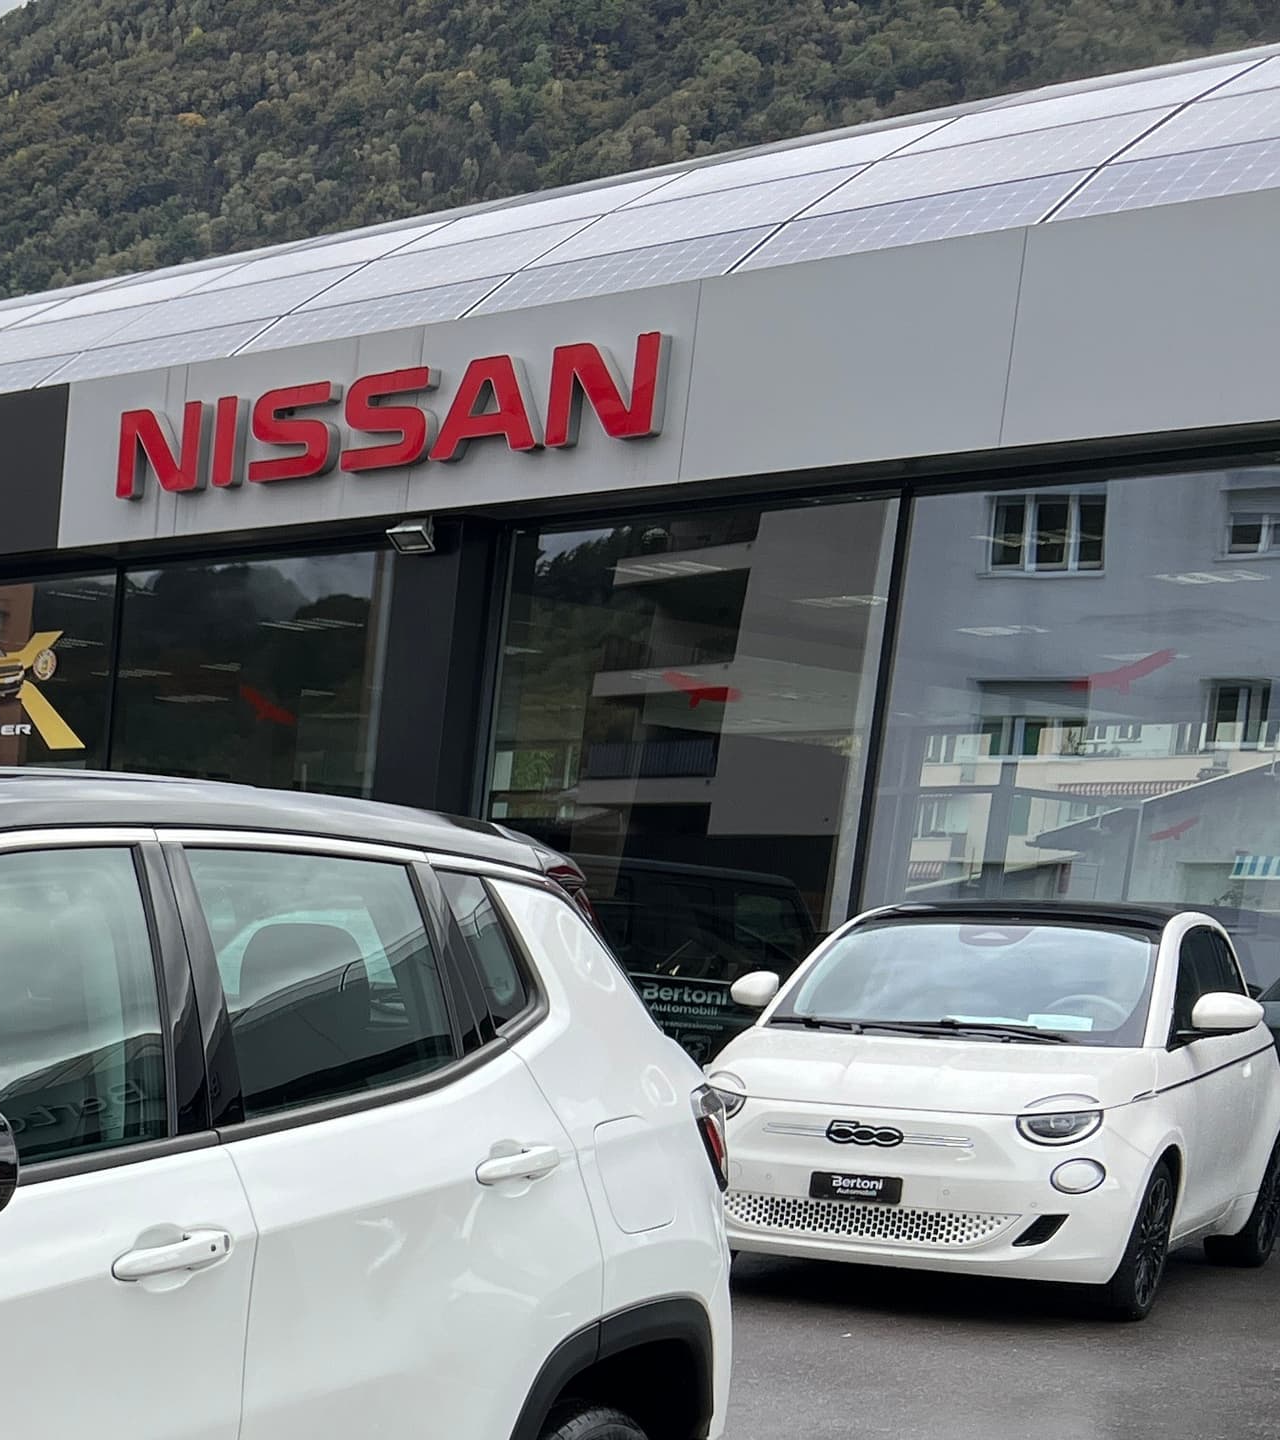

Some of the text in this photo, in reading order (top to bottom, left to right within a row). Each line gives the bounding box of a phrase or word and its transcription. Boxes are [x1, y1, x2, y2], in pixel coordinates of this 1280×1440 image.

[116, 331, 673, 501] NISSAN
[640, 981, 728, 1006] Bertoni
[649, 1001, 718, 1017] Automobili
[825, 1119, 905, 1148] 500
[831, 1174, 884, 1191] Bertoni
